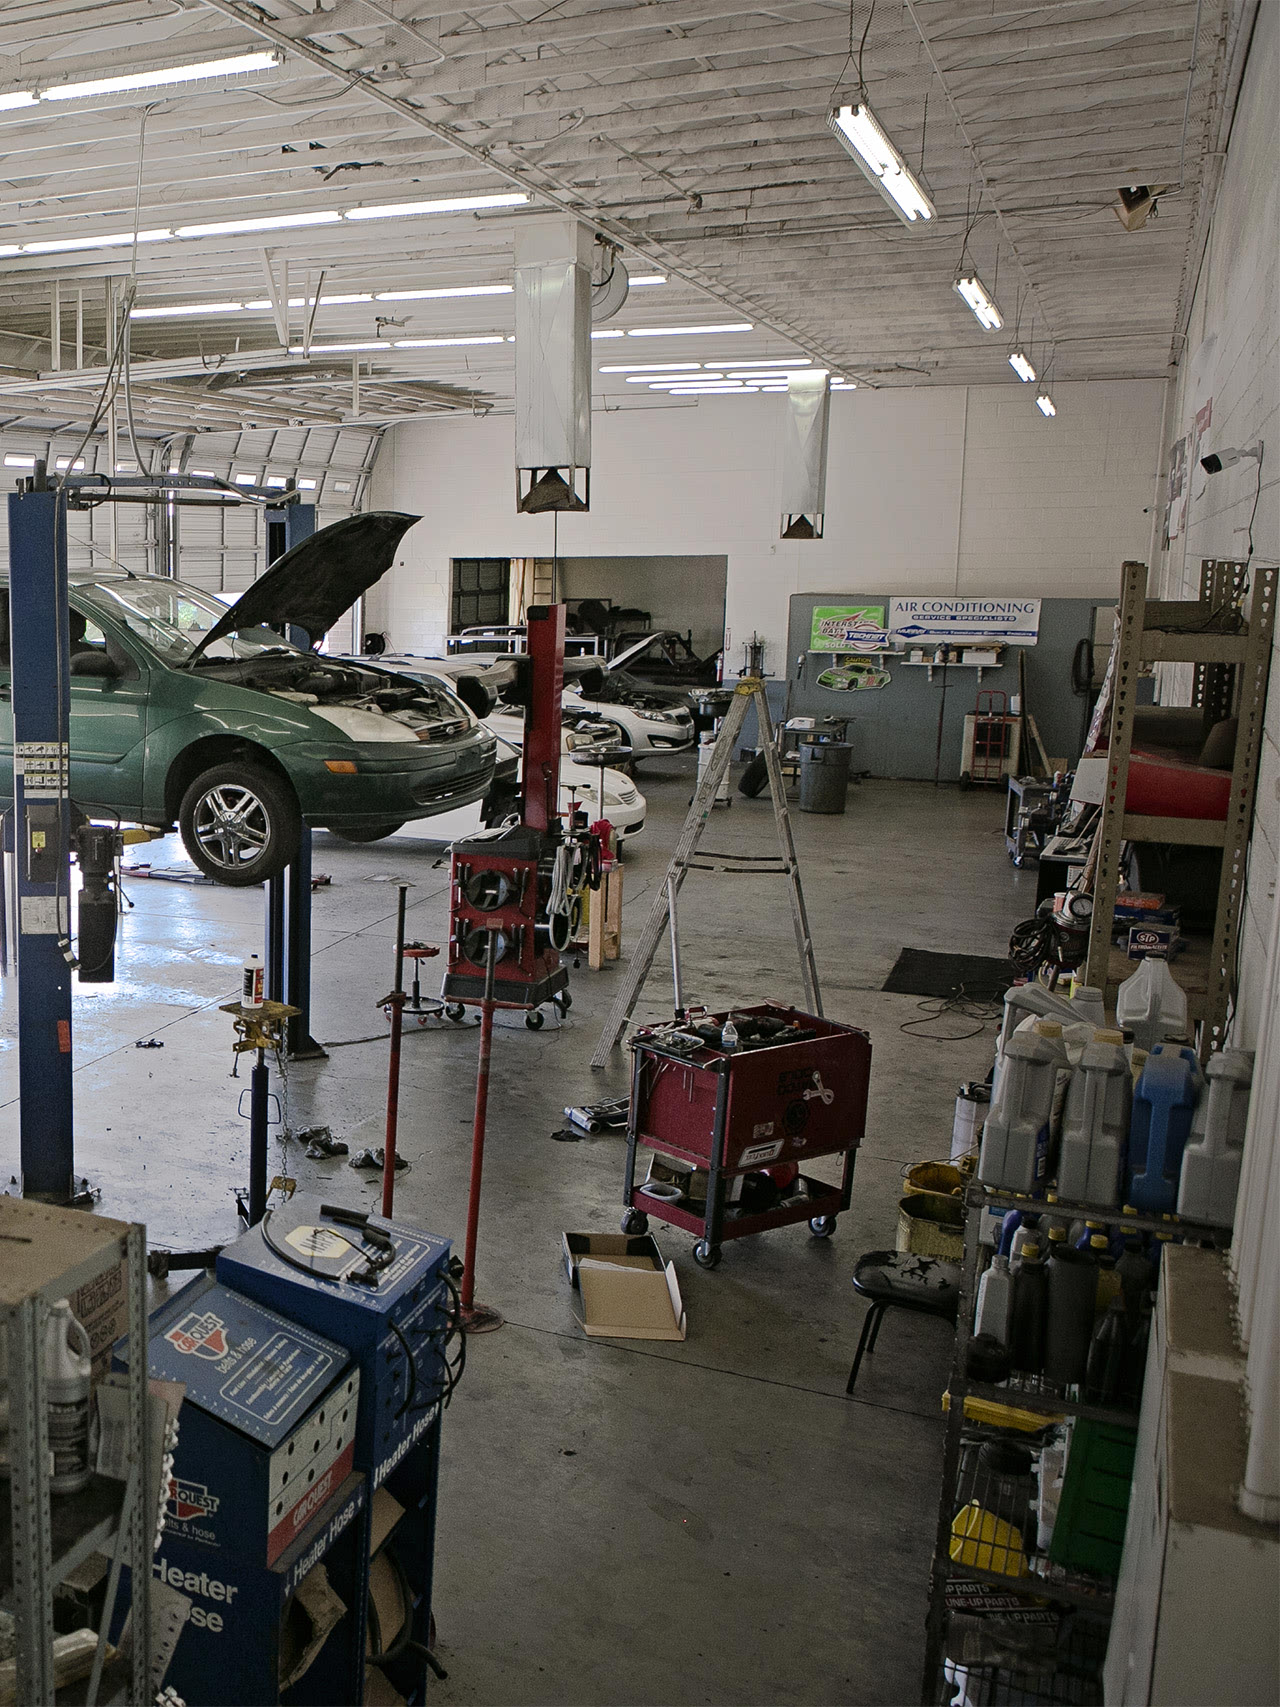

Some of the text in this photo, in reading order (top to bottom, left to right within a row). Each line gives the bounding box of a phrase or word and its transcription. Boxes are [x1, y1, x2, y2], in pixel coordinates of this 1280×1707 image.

[895, 601, 1035, 613] AIR CONDITIONING
[1139, 933, 1156, 943] STP
[176, 1314, 220, 1353] CARQUEST
[215, 1337, 257, 1374] belts & hose
[379, 1408, 434, 1484] Heater Hose
[169, 1487, 217, 1512] RQUEST
[182, 1522, 190, 1534] &
[191, 1524, 216, 1541] hose
[294, 1501, 355, 1586] Heater Hose
[152, 1558, 239, 1605] Heater
[955, 1583, 990, 1596] PARTS
[945, 1596, 1020, 1610] UNE-UP PARTS
